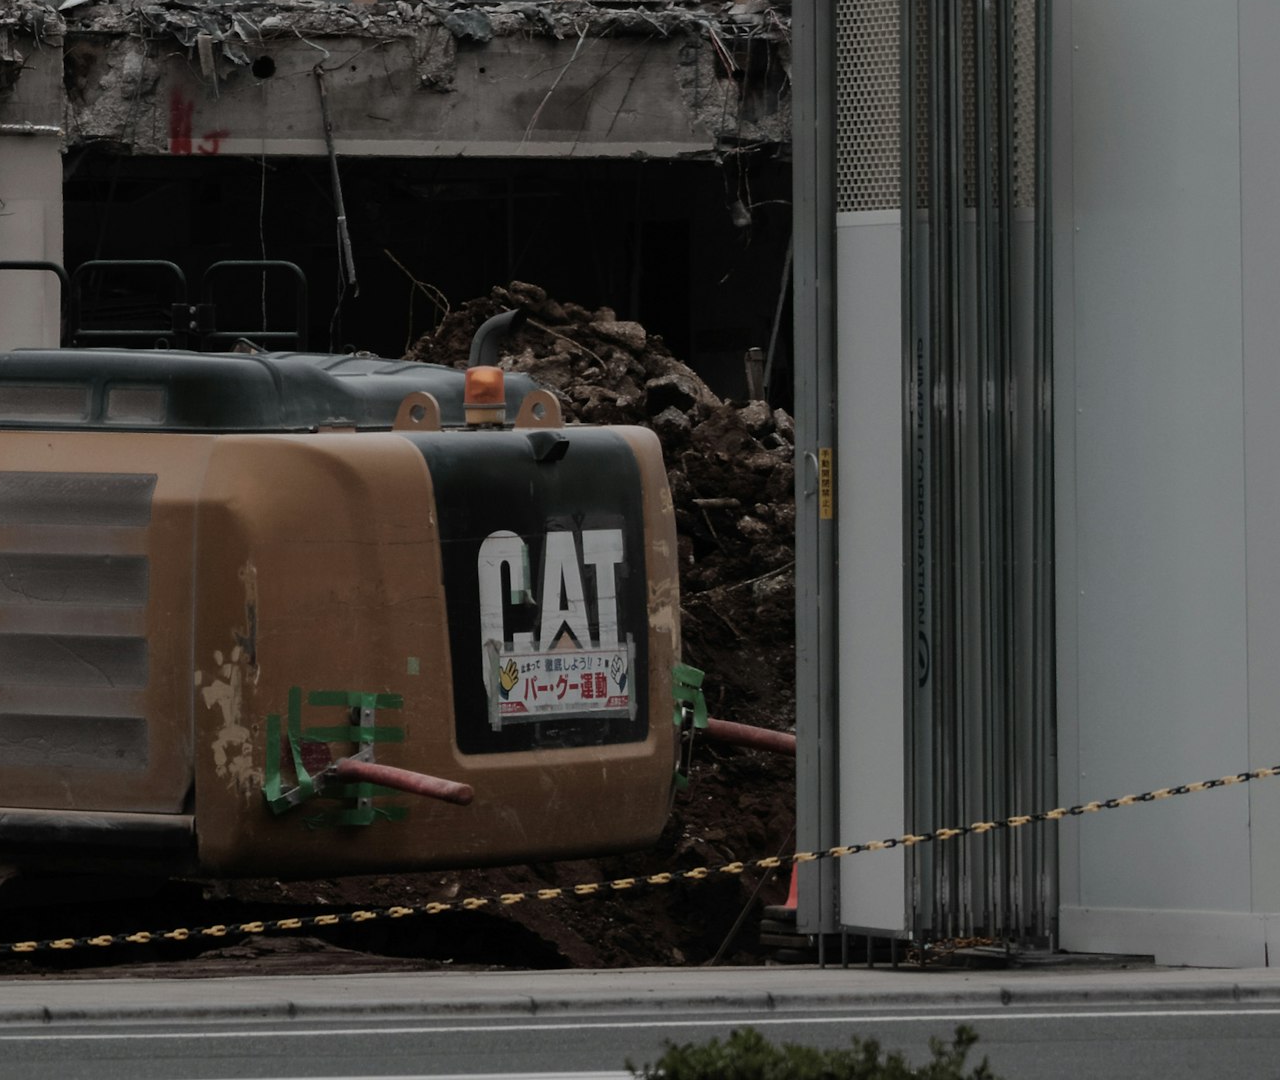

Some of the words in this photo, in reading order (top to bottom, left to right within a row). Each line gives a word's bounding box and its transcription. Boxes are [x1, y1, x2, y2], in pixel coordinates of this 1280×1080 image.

[478, 529, 623, 670] CAT
[524, 672, 607, 700] パー・グー運動
